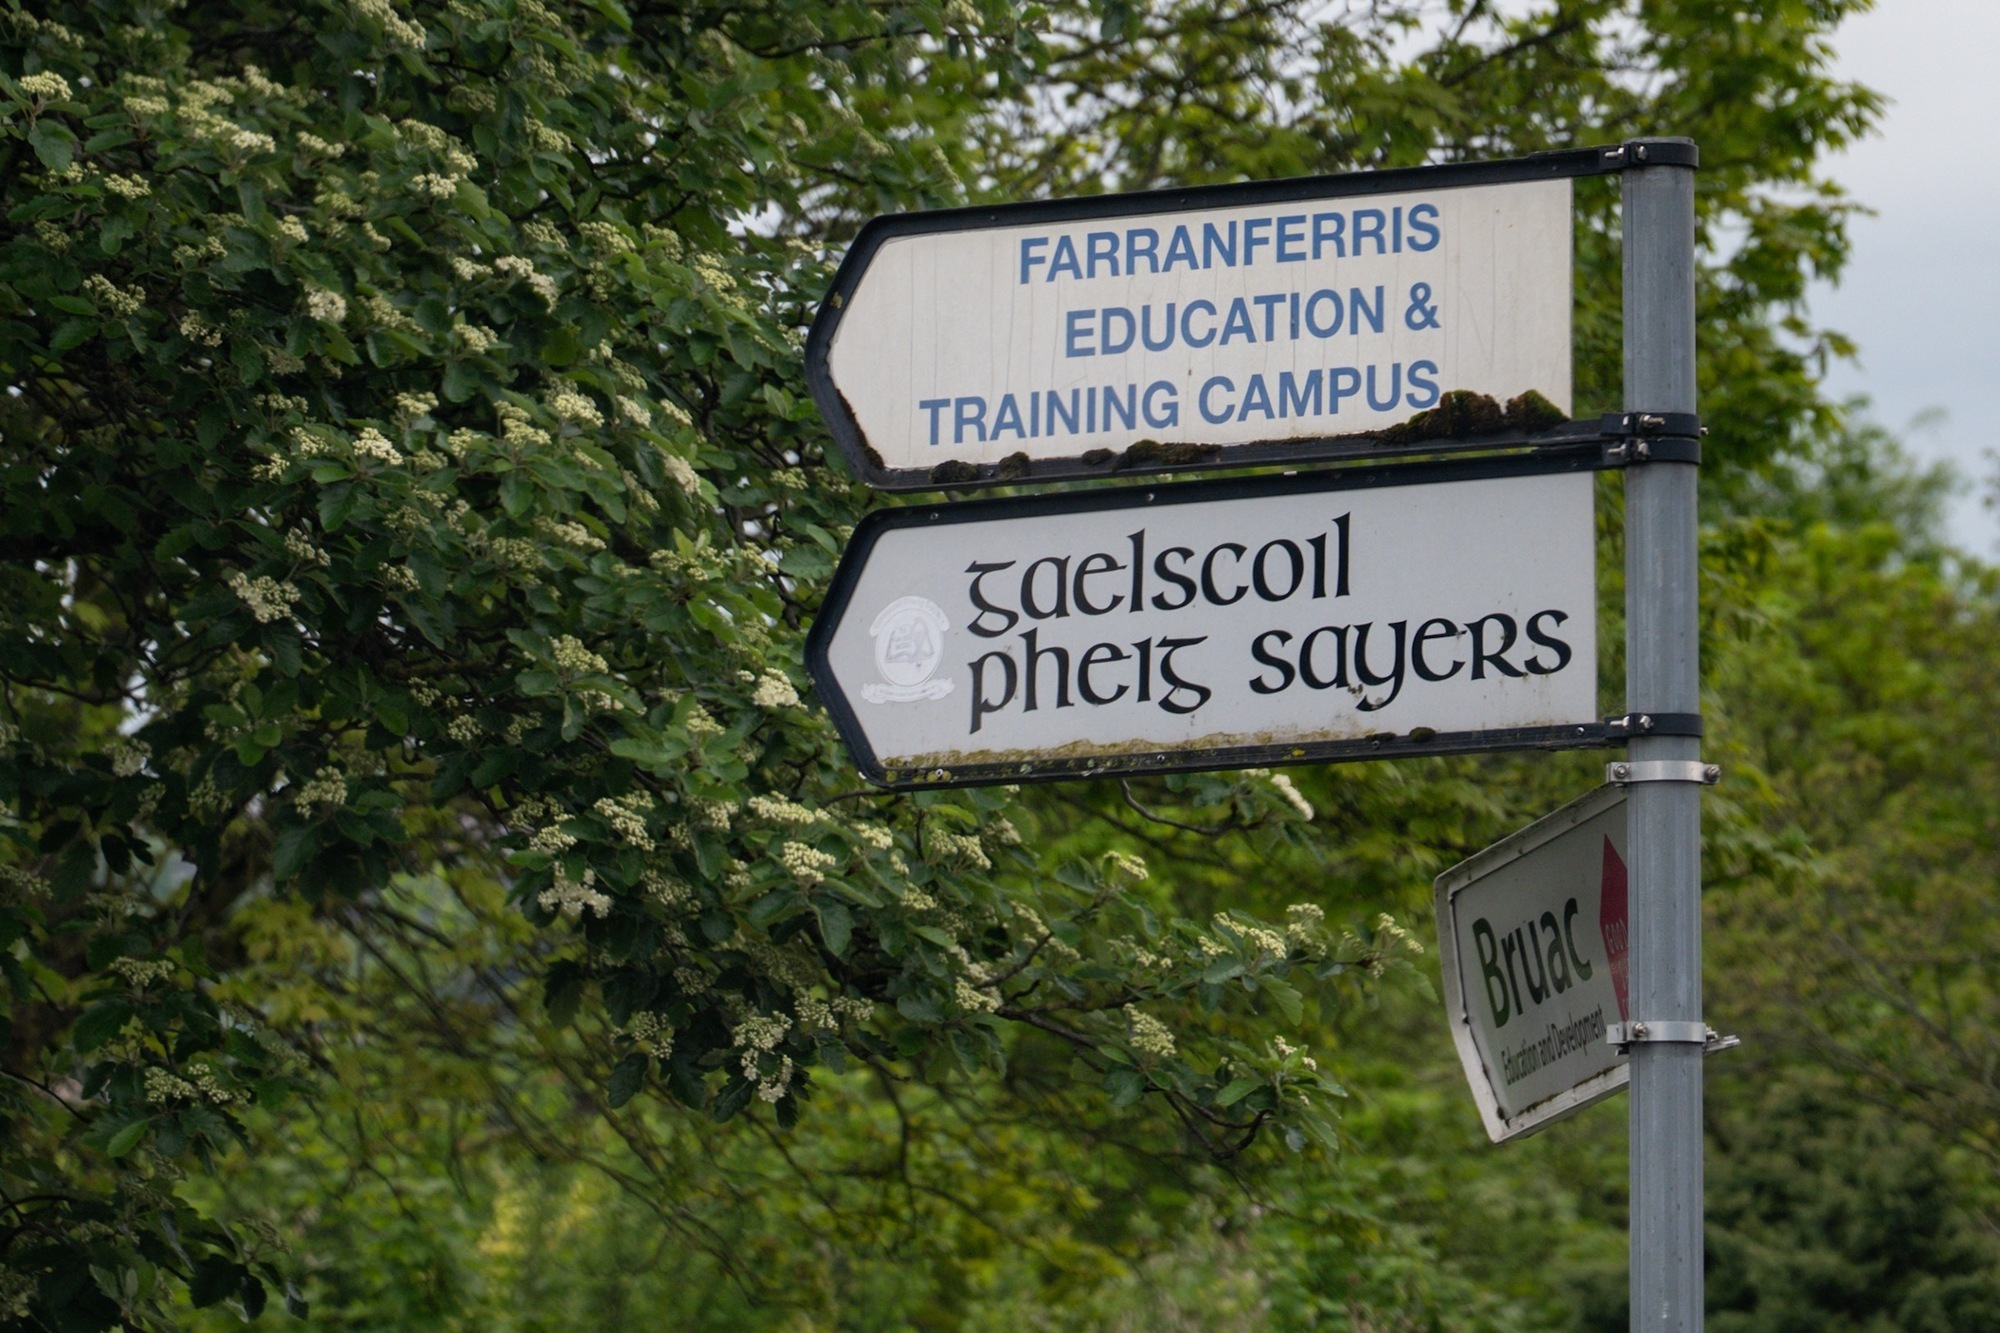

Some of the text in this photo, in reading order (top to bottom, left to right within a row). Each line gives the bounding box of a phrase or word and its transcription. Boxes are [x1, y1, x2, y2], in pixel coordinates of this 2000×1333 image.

[1019, 203, 1440, 284] FARRANFERRIS
[1066, 281, 1441, 358] EDUCATION &
[919, 359, 1440, 446] TRAINING CAMPUS
[1472, 897, 1593, 1029] Bruac
[1501, 1038, 1541, 1086] Education
[1538, 1024, 1556, 1067] and
[1551, 1003, 1607, 1059] Development
